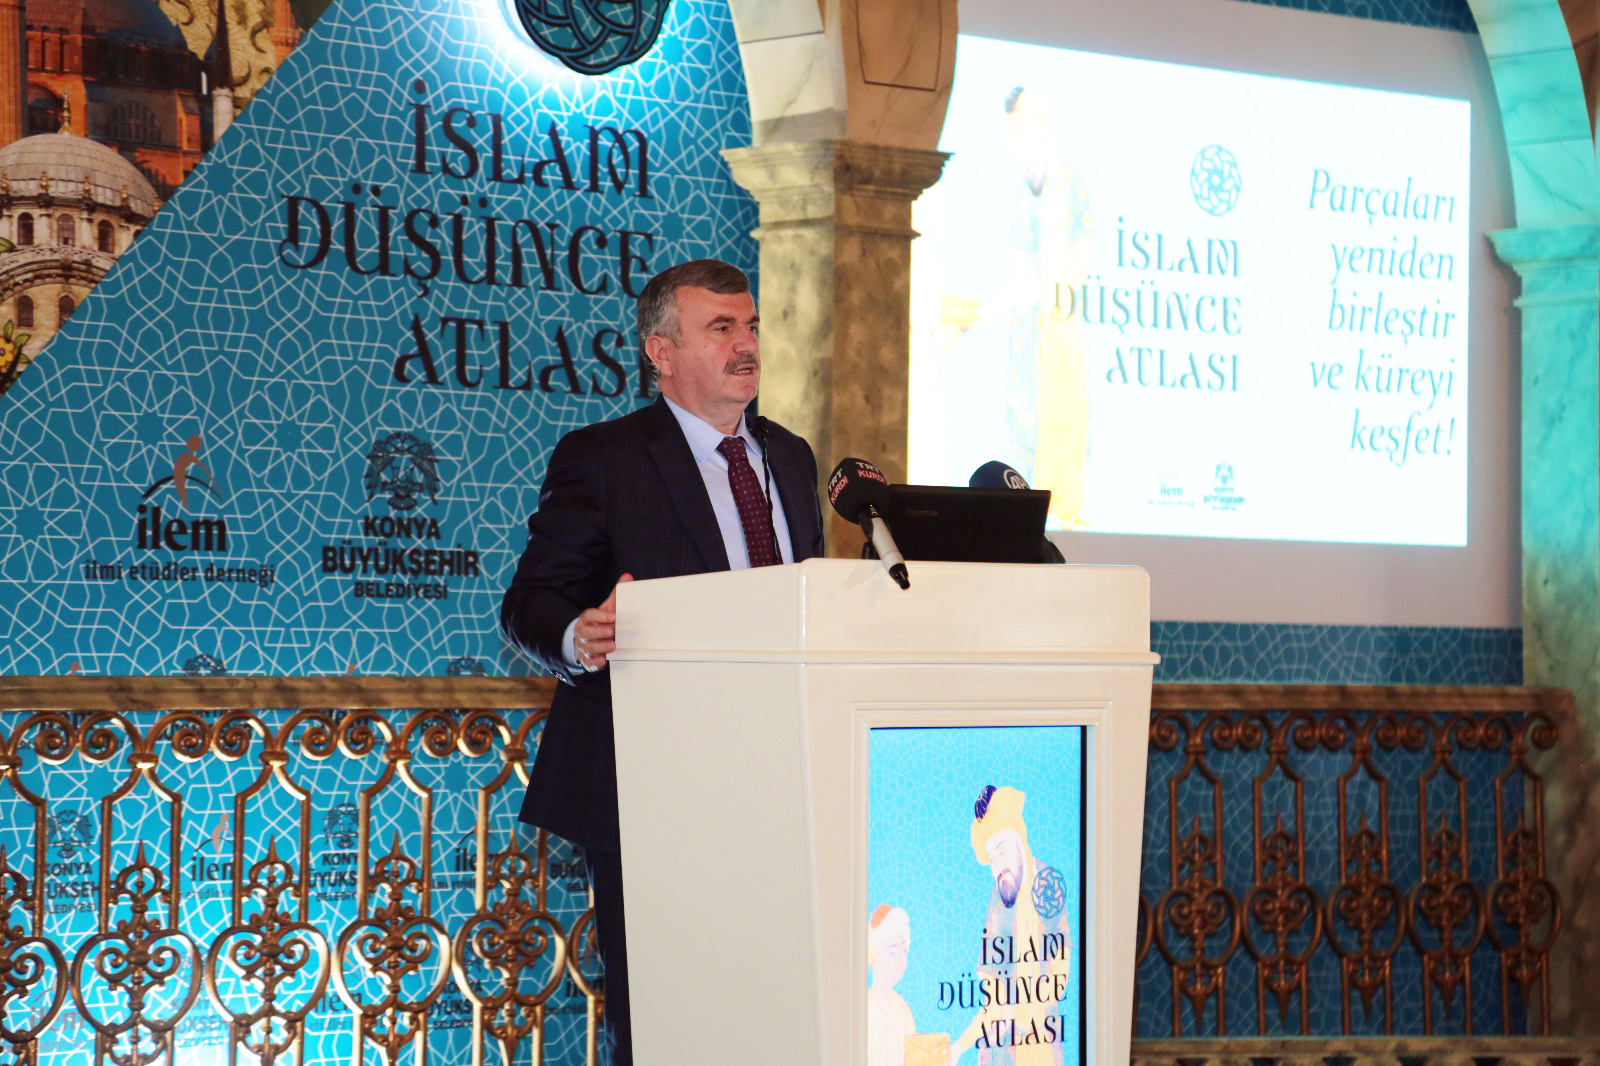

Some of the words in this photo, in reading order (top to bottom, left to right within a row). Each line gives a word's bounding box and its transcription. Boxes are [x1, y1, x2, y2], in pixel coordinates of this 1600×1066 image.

[408, 79, 655, 200] İSLAM
[1308, 167, 1455, 226] Parçaları
[279, 182, 654, 299] DÜŞÜNCE
[1116, 215, 1240, 278] İSLAM
[1330, 235, 1454, 286] yeniden
[1051, 274, 1242, 336] DÜŞÜNCE
[1328, 287, 1456, 349] birleştir
[1106, 345, 1239, 393] ATLASI
[1310, 360, 1344, 391] ve
[1354, 347, 1455, 411] küreyi
[1350, 407, 1455, 467] keşfet!
[137, 503, 228, 552] ilem
[364, 515, 441, 540] KONYA
[85, 559, 123, 580] ilmi
[129, 561, 199, 583] etüdler
[204, 563, 277, 588] derneği
[321, 540, 480, 580] BÜYÜKŞEHİR
[354, 579, 449, 600] BELEDİYESİ
[981, 928, 1068, 966] İSLAM
[937, 970, 1068, 1014] DÜŞÜNCE
[975, 1014, 1067, 1050] ATLASI
